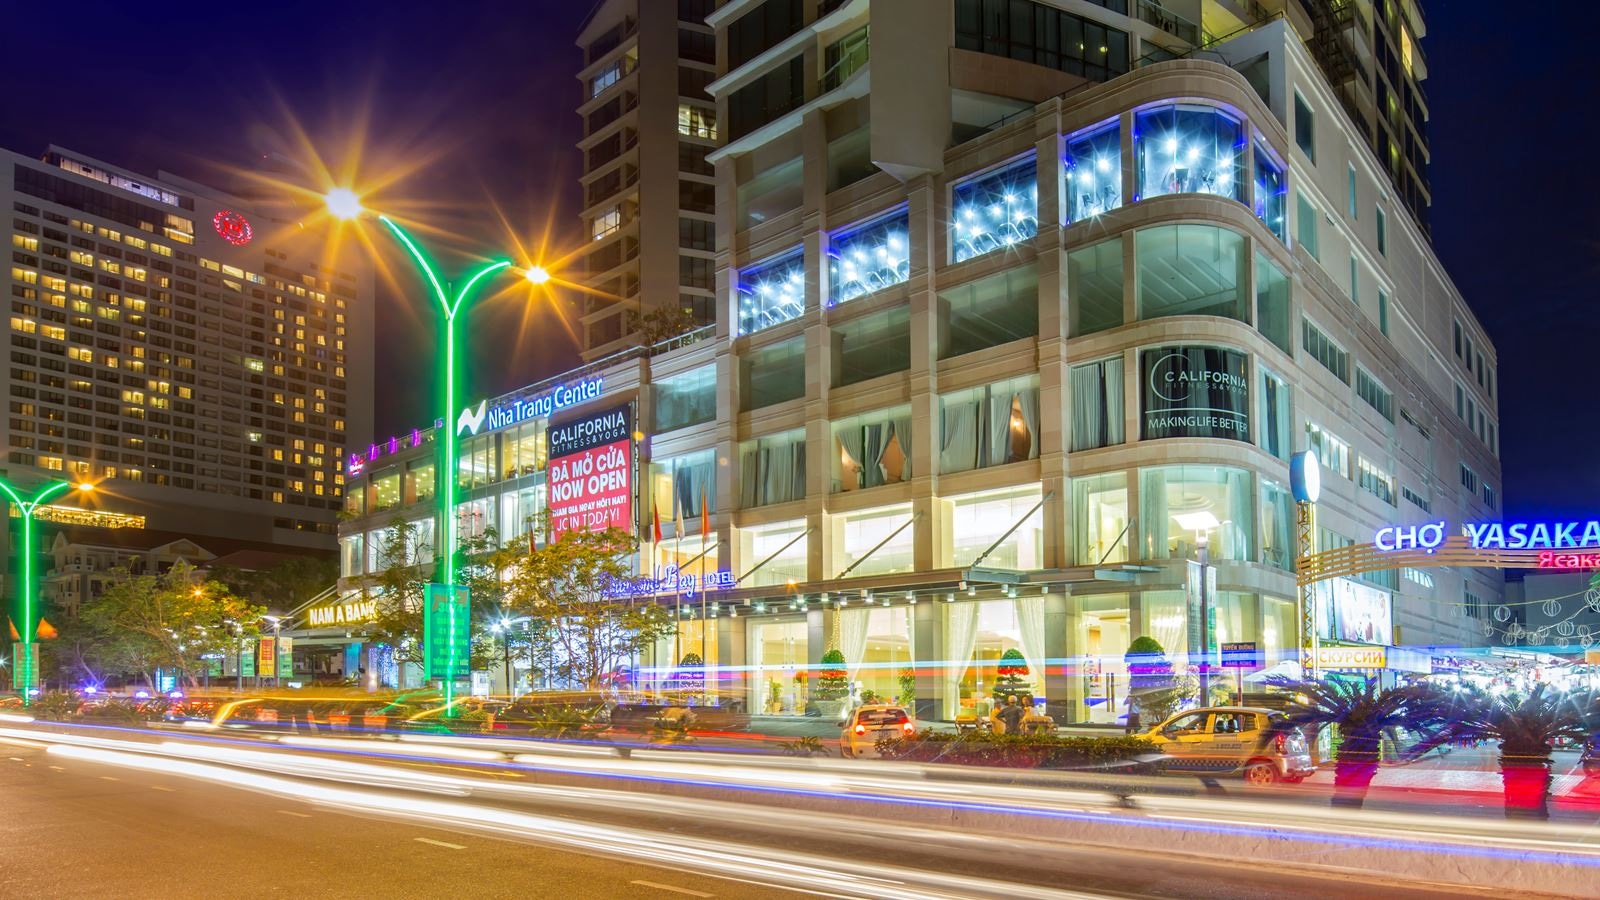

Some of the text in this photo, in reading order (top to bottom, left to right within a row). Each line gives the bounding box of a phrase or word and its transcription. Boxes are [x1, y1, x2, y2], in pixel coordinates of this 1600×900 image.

[1164, 371, 1247, 390] CALIFORNIA
[488, 378, 603, 431] Nha Trang Center
[551, 411, 626, 446] CALIFORNIA
[1219, 418, 1248, 433] BETTER
[551, 446, 626, 483] ĐÃ MỞ CỬA
[551, 469, 627, 503] NOW OPEN
[556, 508, 619, 531] JOIN TODAY!
[1375, 520, 1600, 554] CHỢ YASAKA
[309, 607, 335, 625] NAM
[345, 600, 378, 621] BANK
[1305, 651, 1382, 665] СКУРСИИ
